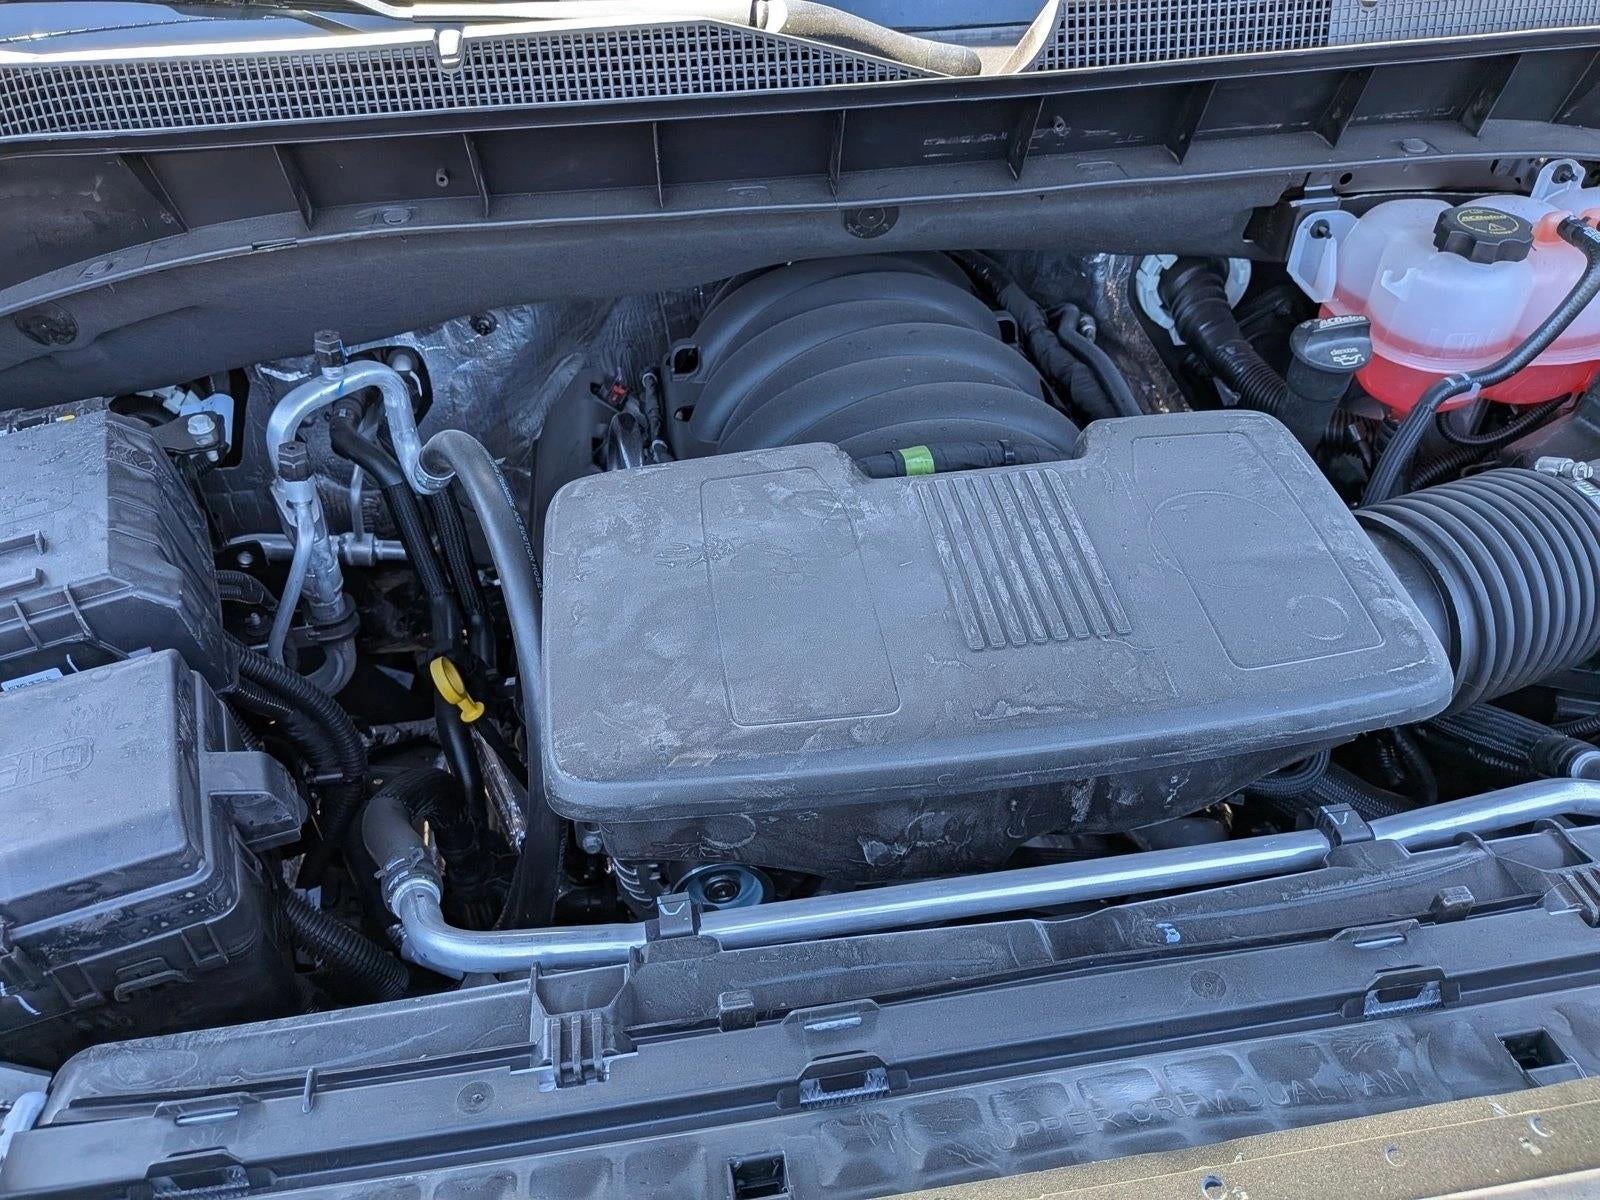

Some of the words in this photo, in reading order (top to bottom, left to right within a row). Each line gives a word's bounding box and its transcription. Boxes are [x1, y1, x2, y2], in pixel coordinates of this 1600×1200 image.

[1461, 214, 1507, 223] ACDelco
[1319, 315, 1367, 329] ACDelco
[1330, 347, 1359, 356] dexos
[518, 523, 536, 562] SUCTION
[531, 562, 543, 589] HOSE
